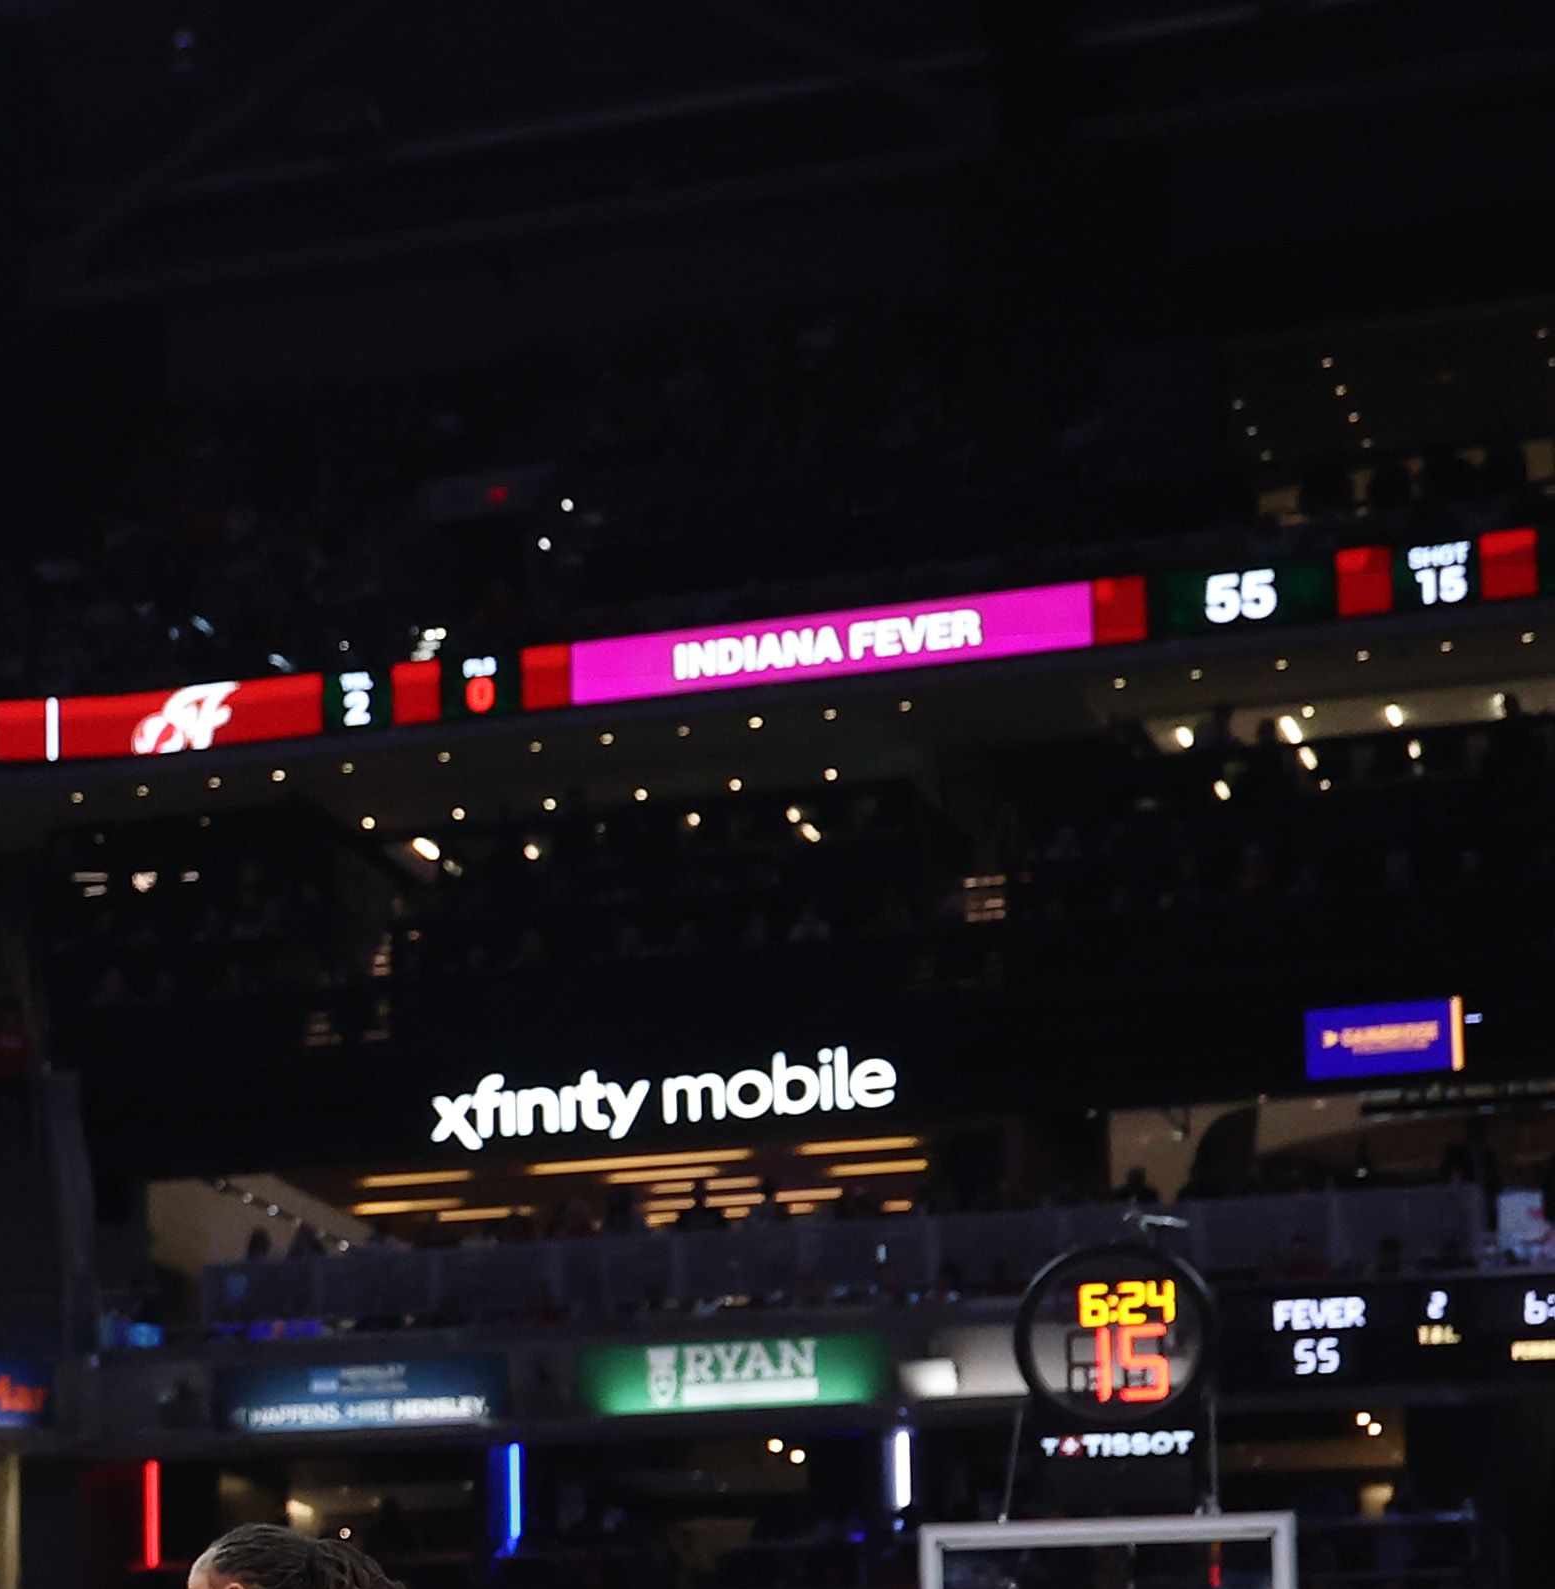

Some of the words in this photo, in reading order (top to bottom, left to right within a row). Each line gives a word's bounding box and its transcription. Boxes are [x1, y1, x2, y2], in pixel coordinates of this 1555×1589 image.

[1407, 541, 1471, 571] SHOT
[1204, 568, 1279, 624] 55
[1414, 565, 1468, 605] 15
[672, 622, 844, 682] INDIANA
[848, 608, 983, 661] FEVER
[343, 692, 372, 727] 2
[465, 675, 497, 713] 0
[431, 1074, 652, 1151] xfinity
[661, 1045, 897, 1126] mobile
[1078, 1279, 1177, 1329] 6:24
[1273, 1296, 1367, 1332] FEVER
[683, 1338, 817, 1385] RYAN
[1095, 1323, 1172, 1404] 15
[1081, 1429, 1196, 1458] TISSOT
